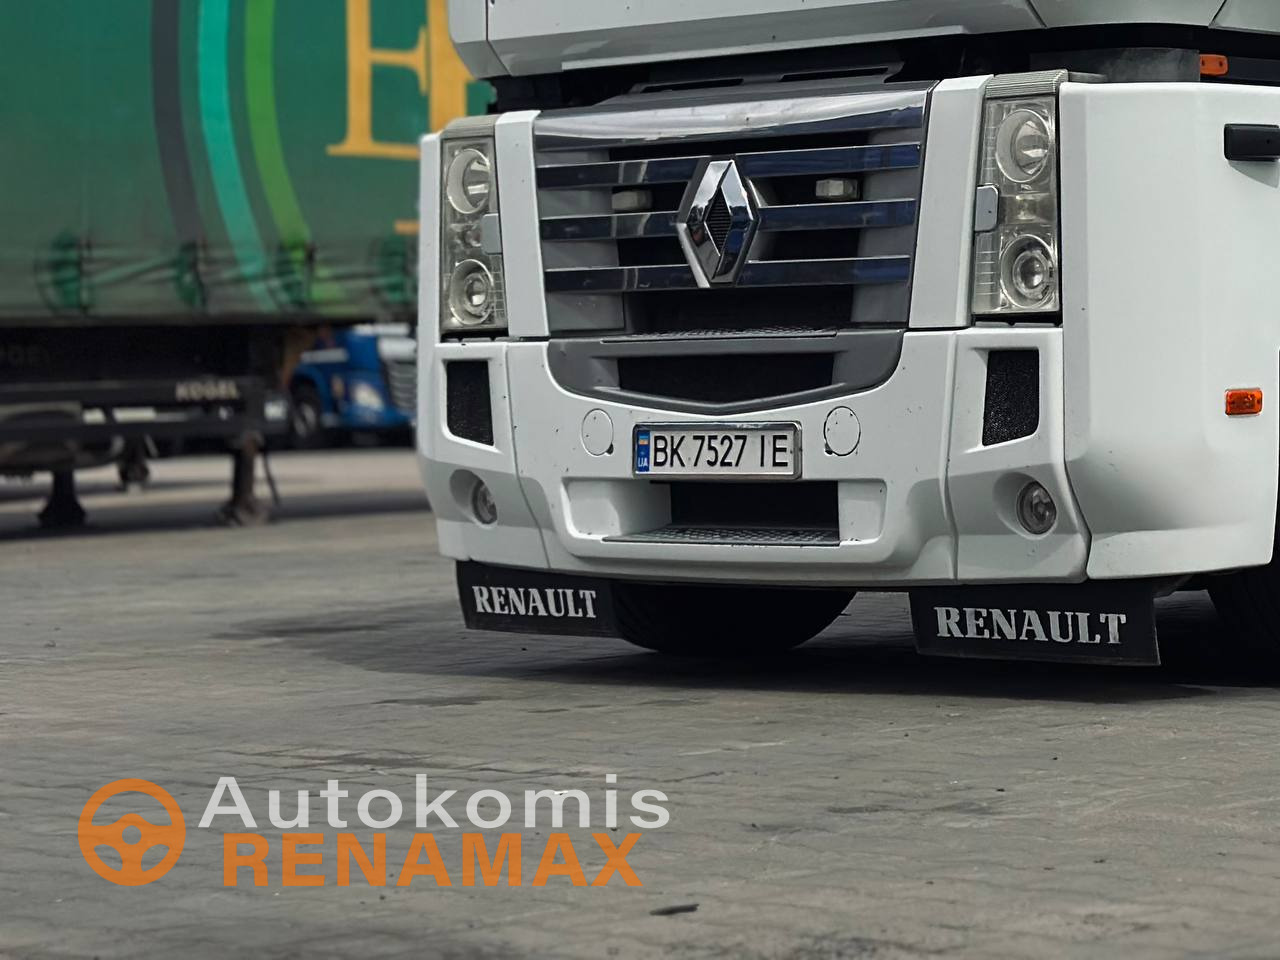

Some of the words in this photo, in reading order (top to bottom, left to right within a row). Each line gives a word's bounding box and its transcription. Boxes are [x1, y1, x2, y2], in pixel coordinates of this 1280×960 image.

[653, 435, 685, 467] BK
[692, 435, 747, 467] 7527
[760, 435, 788, 467] IE
[472, 586, 596, 618] RENAULT
[934, 607, 1126, 643] RENAULT
